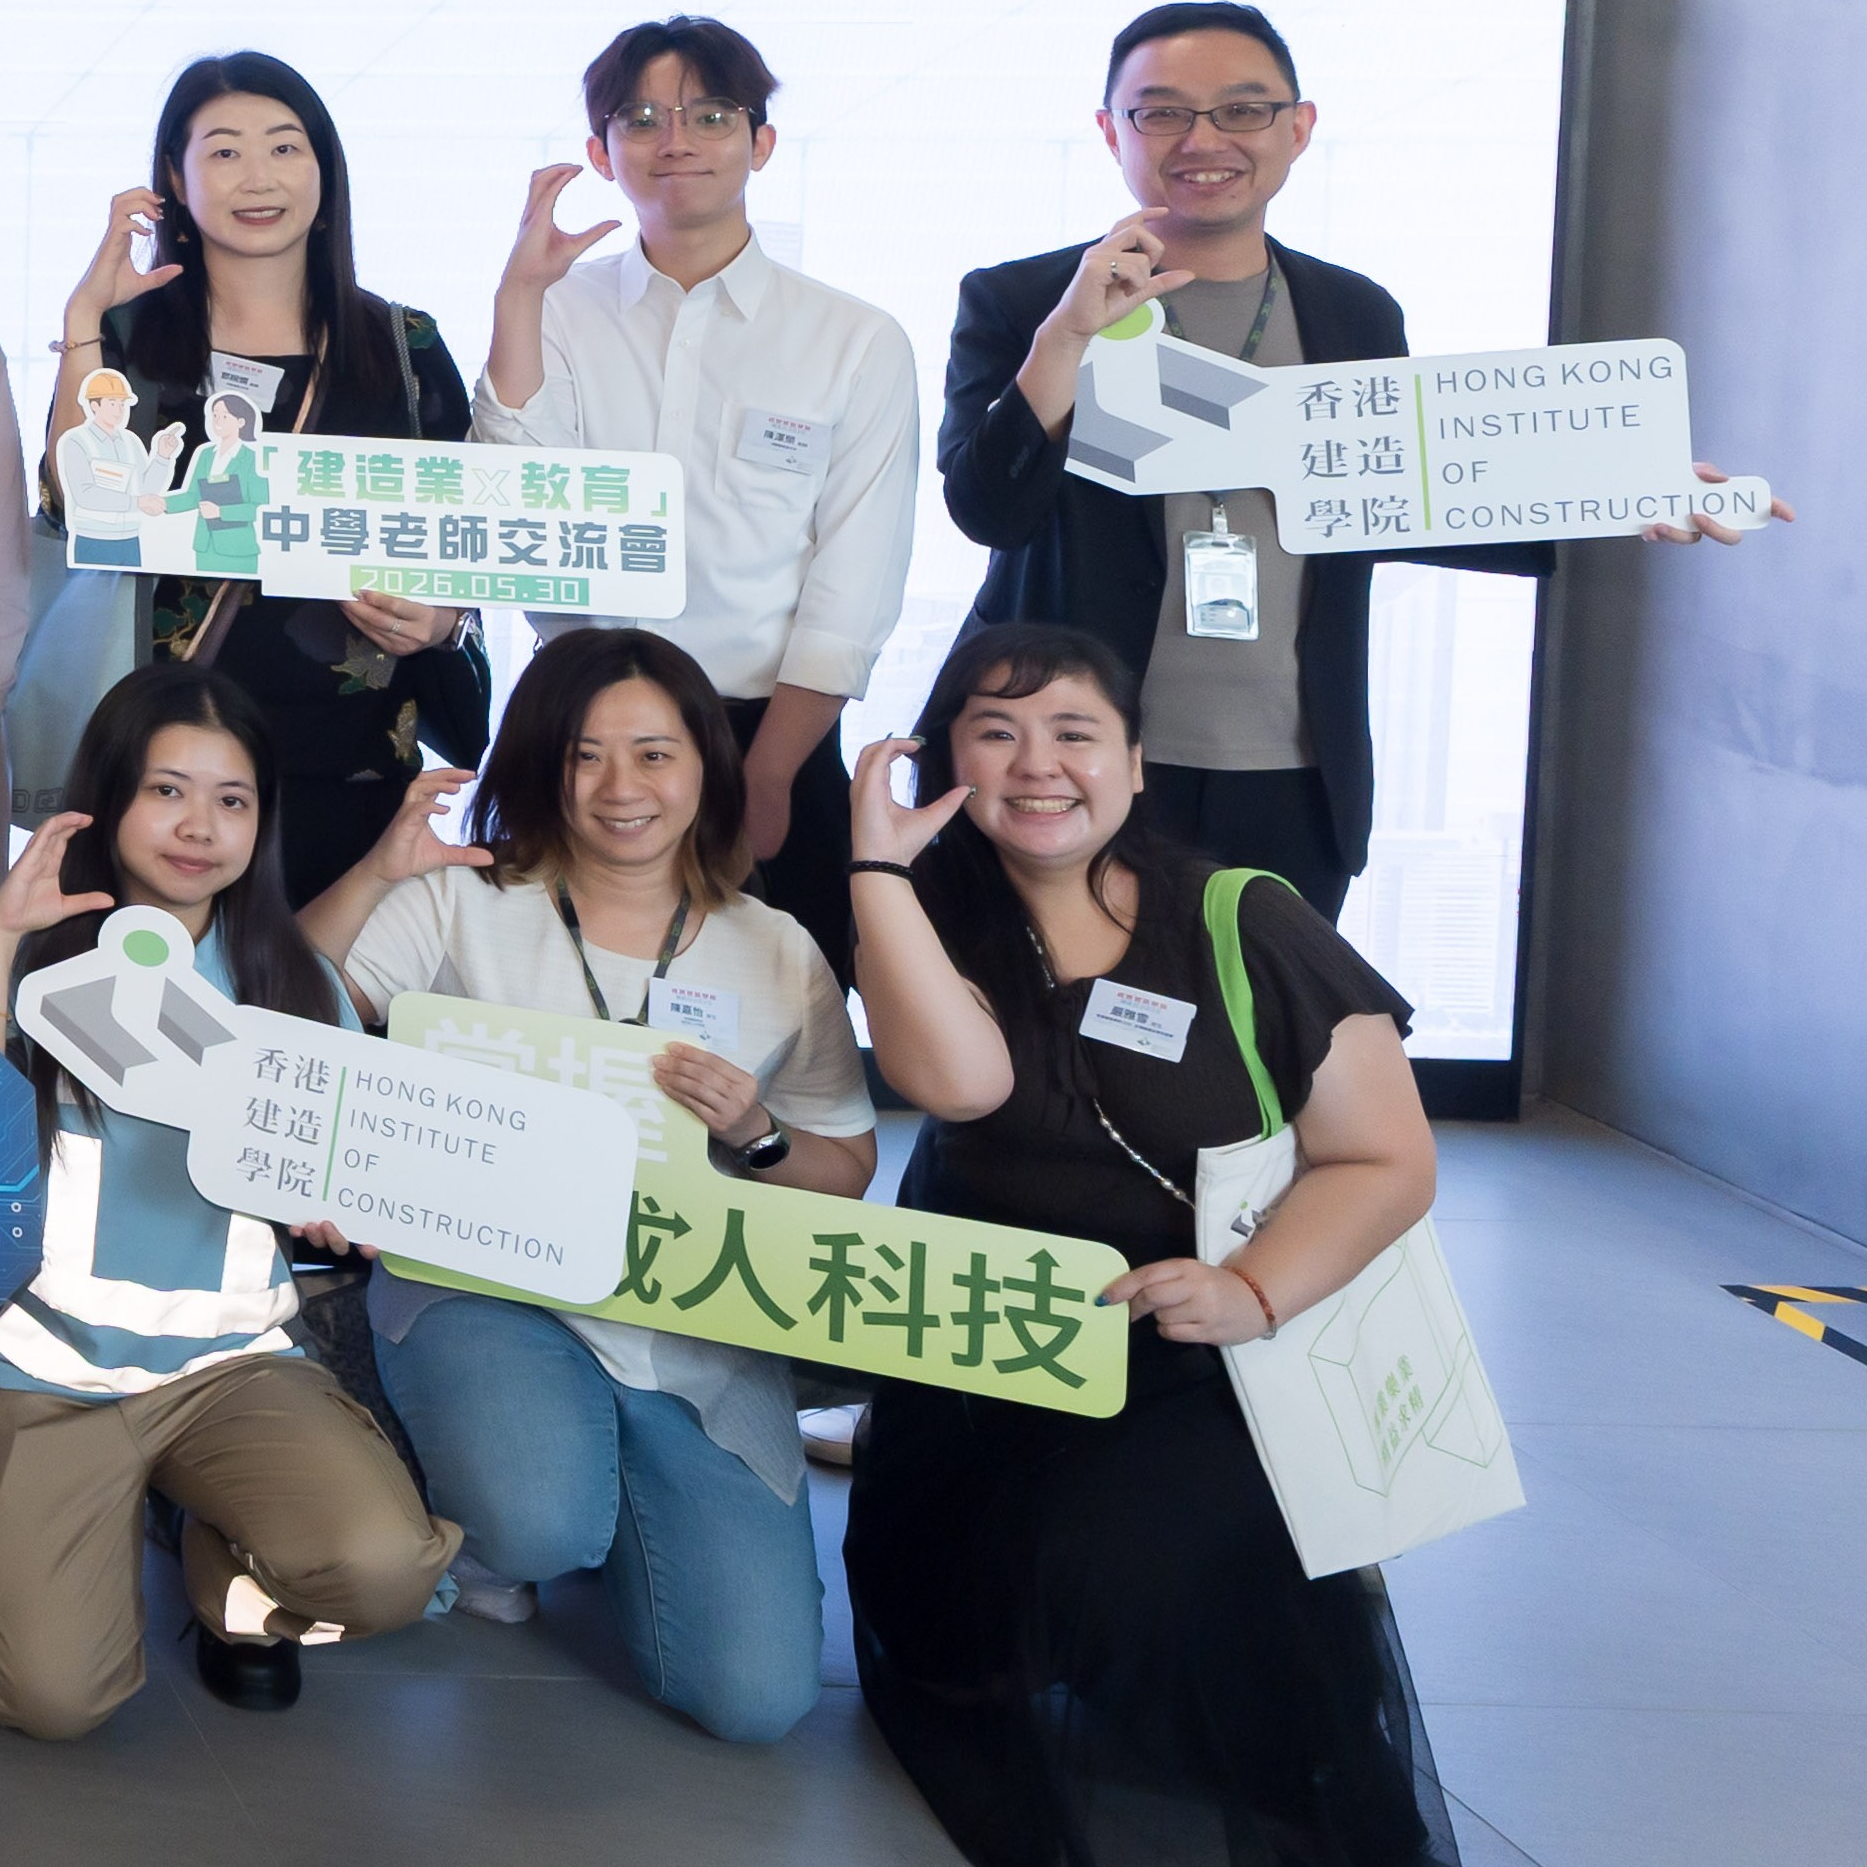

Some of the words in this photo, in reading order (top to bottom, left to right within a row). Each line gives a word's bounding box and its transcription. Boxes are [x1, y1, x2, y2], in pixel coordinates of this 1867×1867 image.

[1295, 375, 1402, 422] 香港
[1436, 365, 1546, 395] HONG
[1561, 356, 1673, 386] KONG
[1440, 404, 1641, 440] INSTITUTE
[1299, 435, 1406, 482] 建造
[1442, 460, 1489, 485] OF
[1303, 494, 1412, 540] 學院
[1445, 490, 1757, 531] CONSTRUCTION
[260, 504, 668, 574] 中學老師交流會
[360, 568, 581, 604] 2026.05.30
[251, 1046, 331, 1096] 香港
[241, 1095, 323, 1146] 建造
[356, 1069, 435, 1108] HONG
[446, 1092, 527, 1132] KONG
[350, 1108, 497, 1165] INSTITUTE
[235, 1146, 317, 1199] 學院
[344, 1148, 380, 1173] OF
[338, 1186, 565, 1267] CONSTRUCTION
